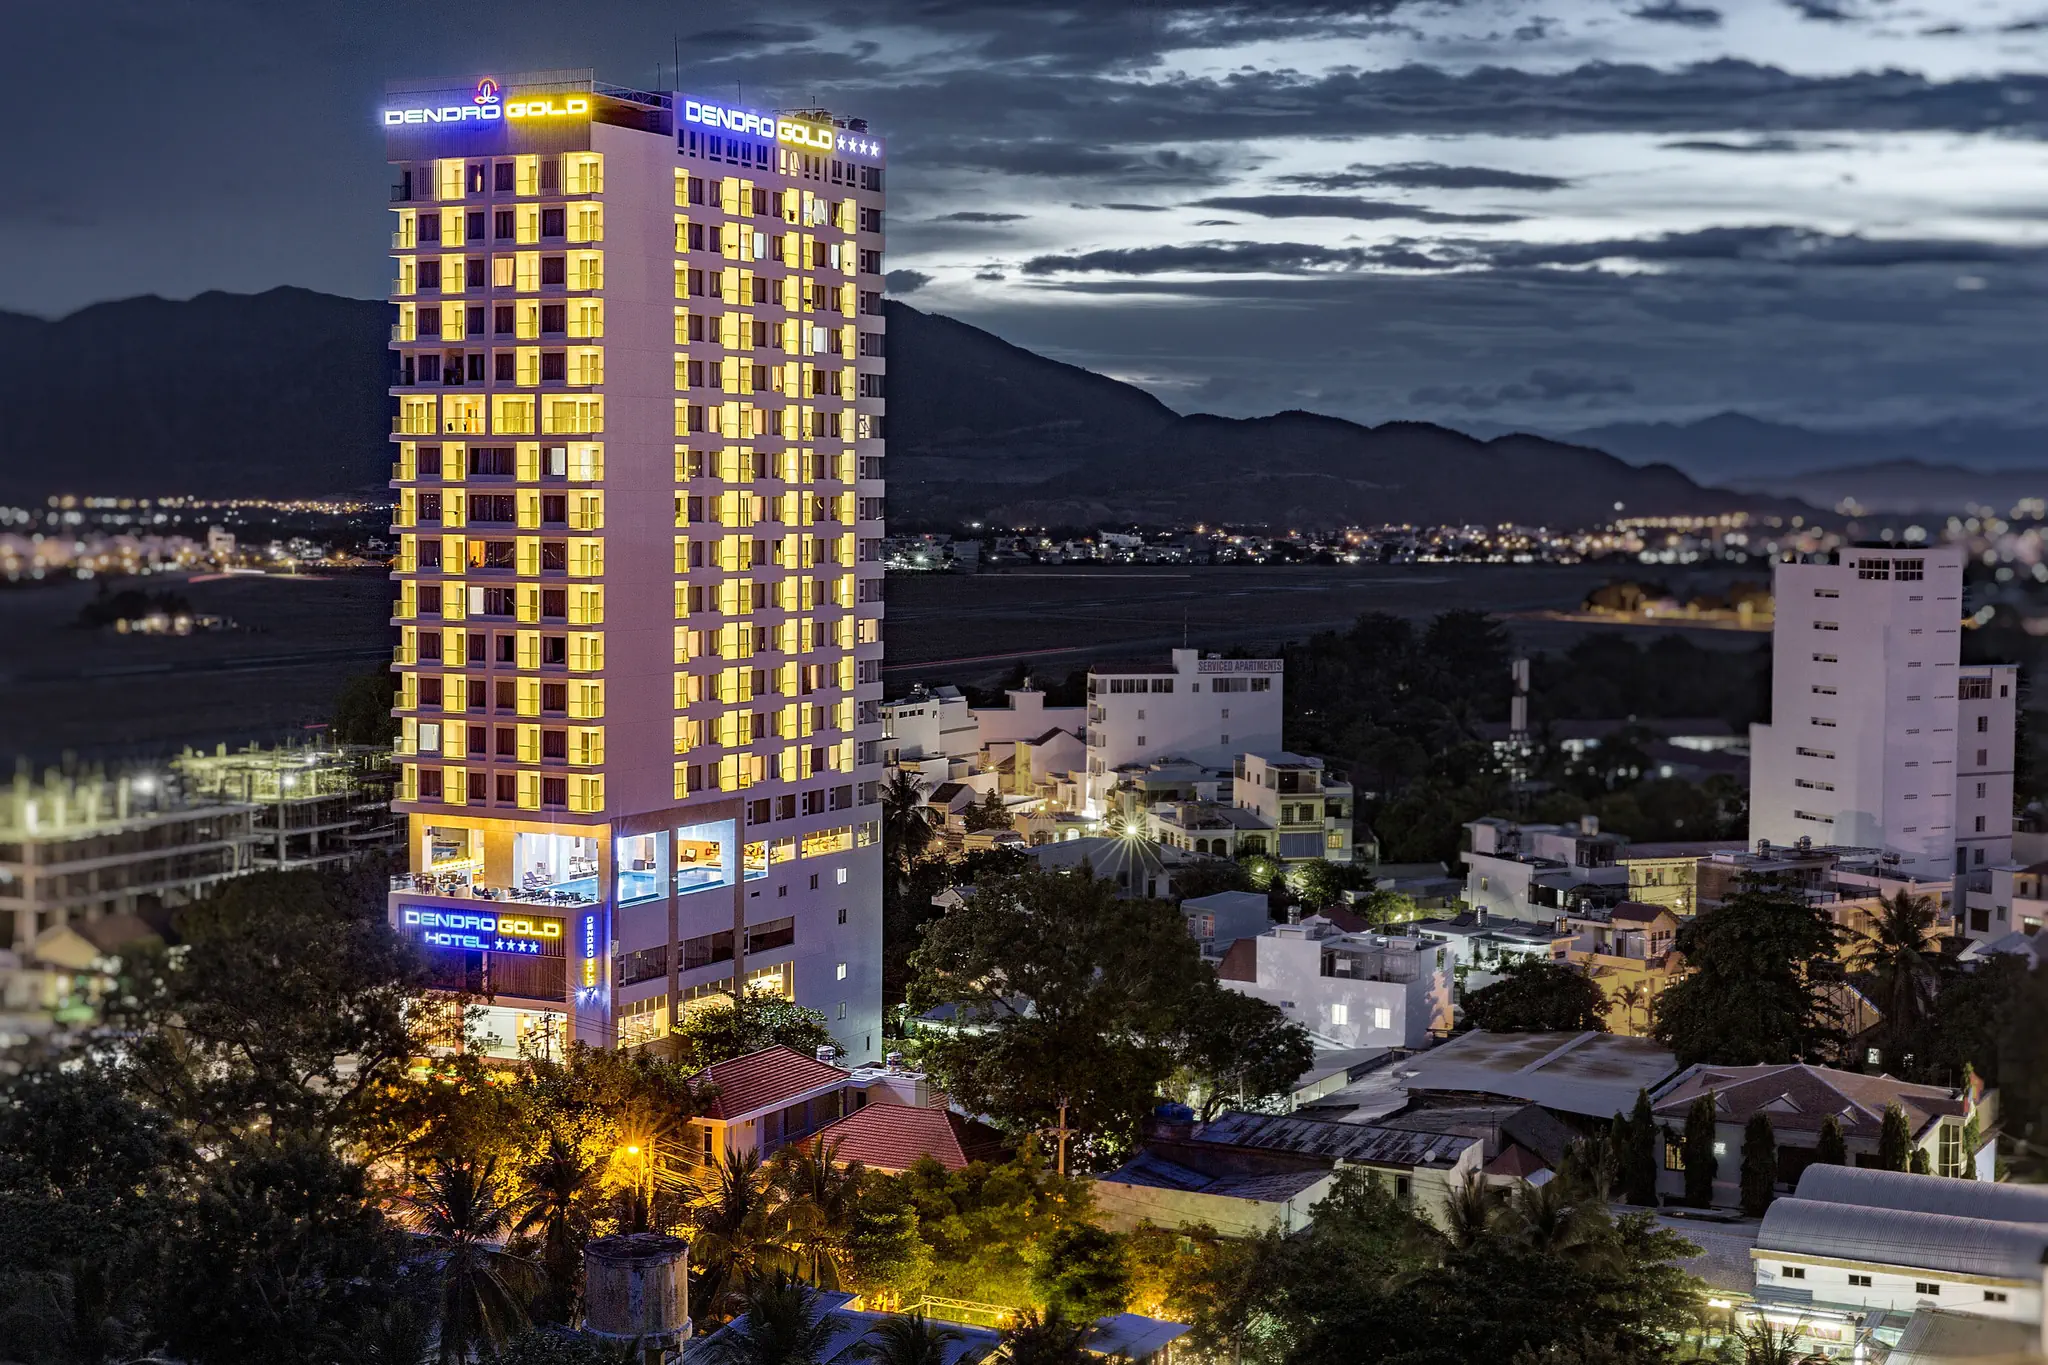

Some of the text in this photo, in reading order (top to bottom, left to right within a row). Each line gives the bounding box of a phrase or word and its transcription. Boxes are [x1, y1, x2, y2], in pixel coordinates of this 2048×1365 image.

[384, 99, 589, 125] DENDRO GOLD
[684, 100, 833, 150] DENDRO GOLD
[1198, 660, 1282, 671] SERVICED APARTMENTS
[404, 910, 561, 938] DENDRO GOLD
[424, 931, 490, 949] HOTEL
